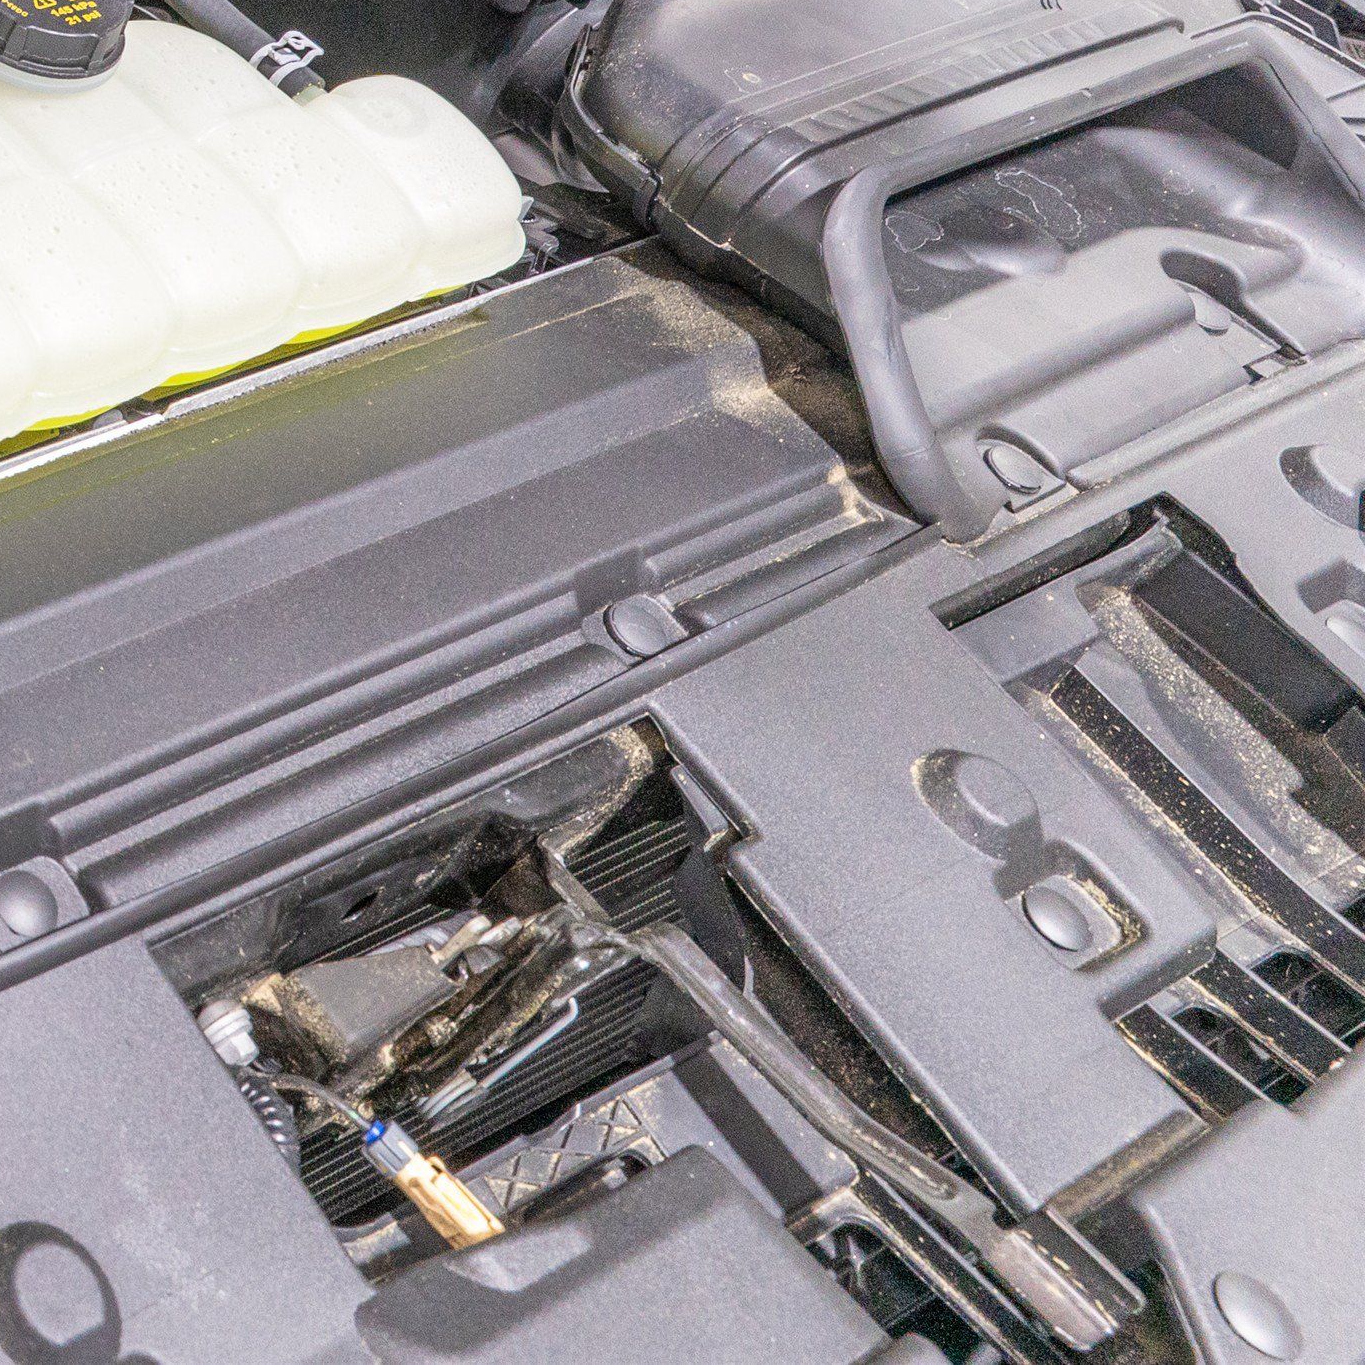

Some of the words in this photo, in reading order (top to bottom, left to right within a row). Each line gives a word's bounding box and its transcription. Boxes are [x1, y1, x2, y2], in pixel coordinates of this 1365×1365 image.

[50, 5, 74, 17] 145
[65, 15, 82, 26] 21
[82, 10, 102, 22] psi
